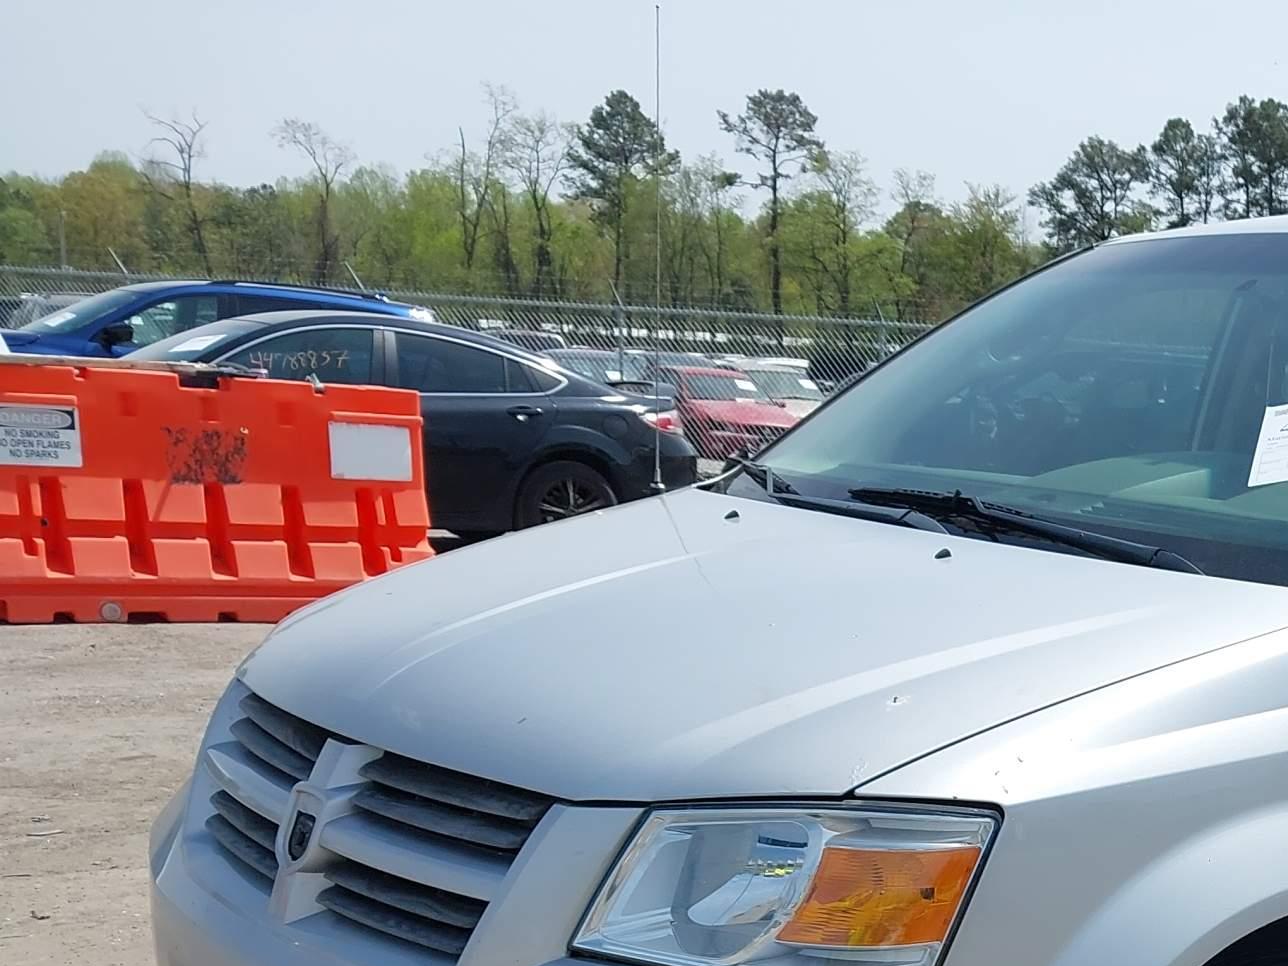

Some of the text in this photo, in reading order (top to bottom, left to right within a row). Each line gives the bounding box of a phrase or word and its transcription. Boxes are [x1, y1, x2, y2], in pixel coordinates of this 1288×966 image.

[4, 429, 60, 439] NO SMOKING
[0, 438, 71, 450] O OPEN FLAMES
[9, 449, 59, 459] NO SPARKS
